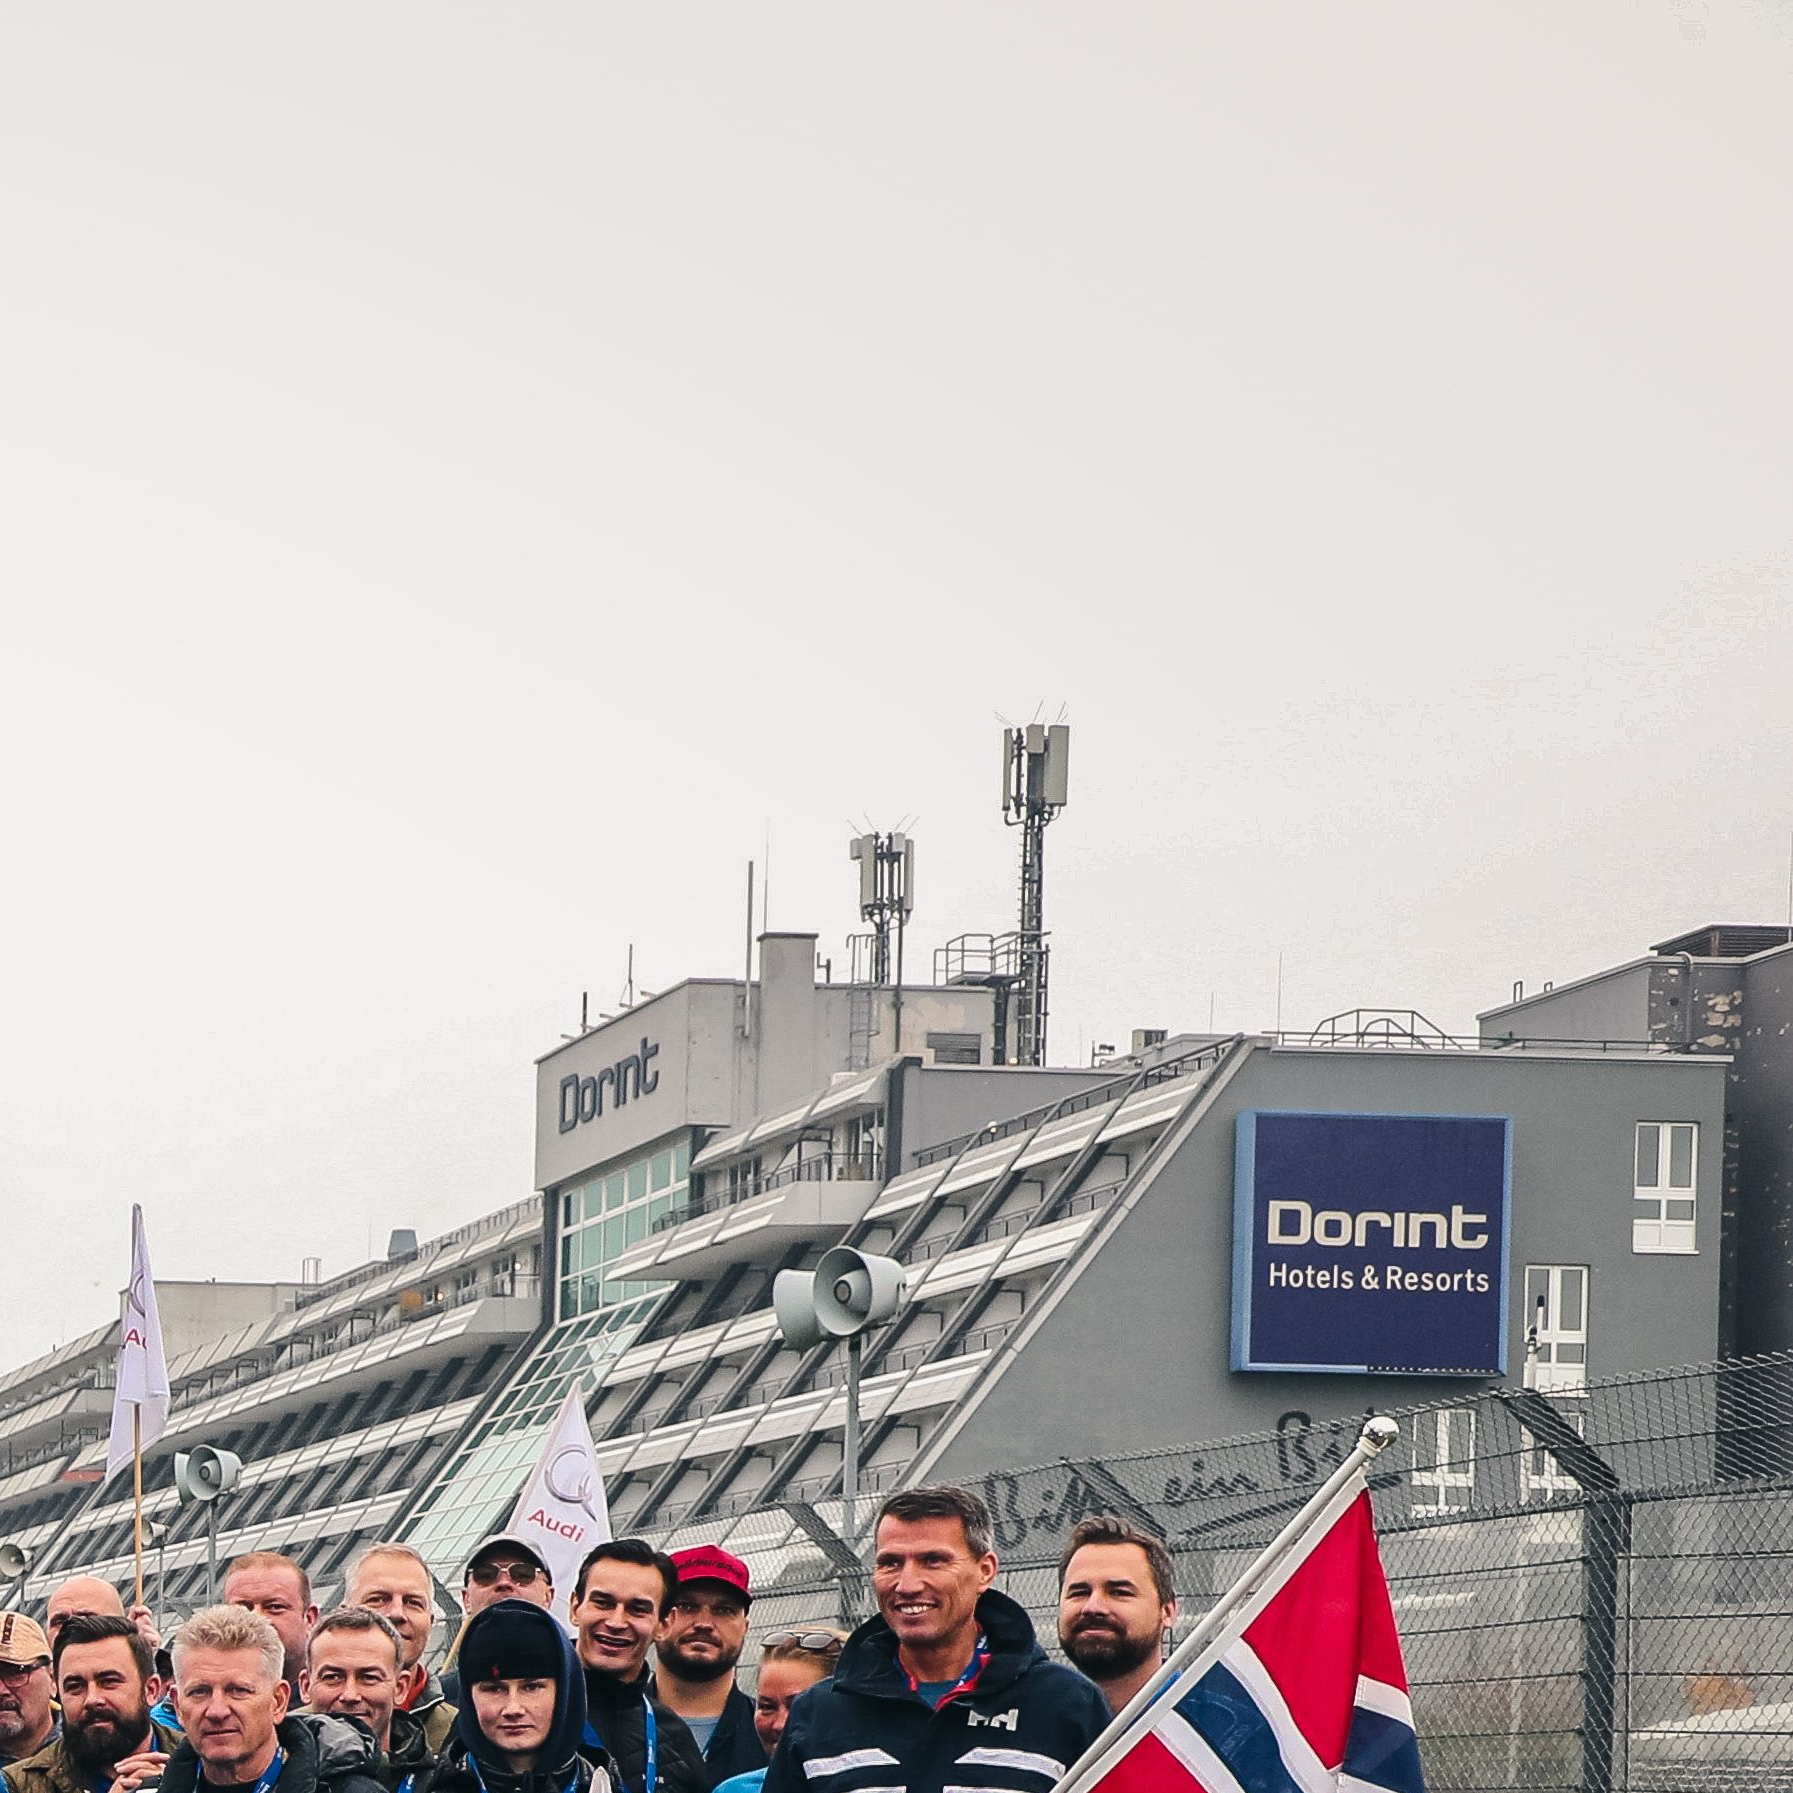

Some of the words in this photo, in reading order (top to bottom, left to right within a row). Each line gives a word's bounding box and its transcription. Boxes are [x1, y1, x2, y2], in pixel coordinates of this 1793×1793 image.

[559, 1036, 659, 1135] Dorint
[1268, 1200, 1489, 1249] Dorint
[1269, 1263, 1354, 1289] Hotels
[1361, 1265, 1380, 1290] &
[1386, 1266, 1489, 1292] Resorts
[528, 1508, 585, 1543] Audi
